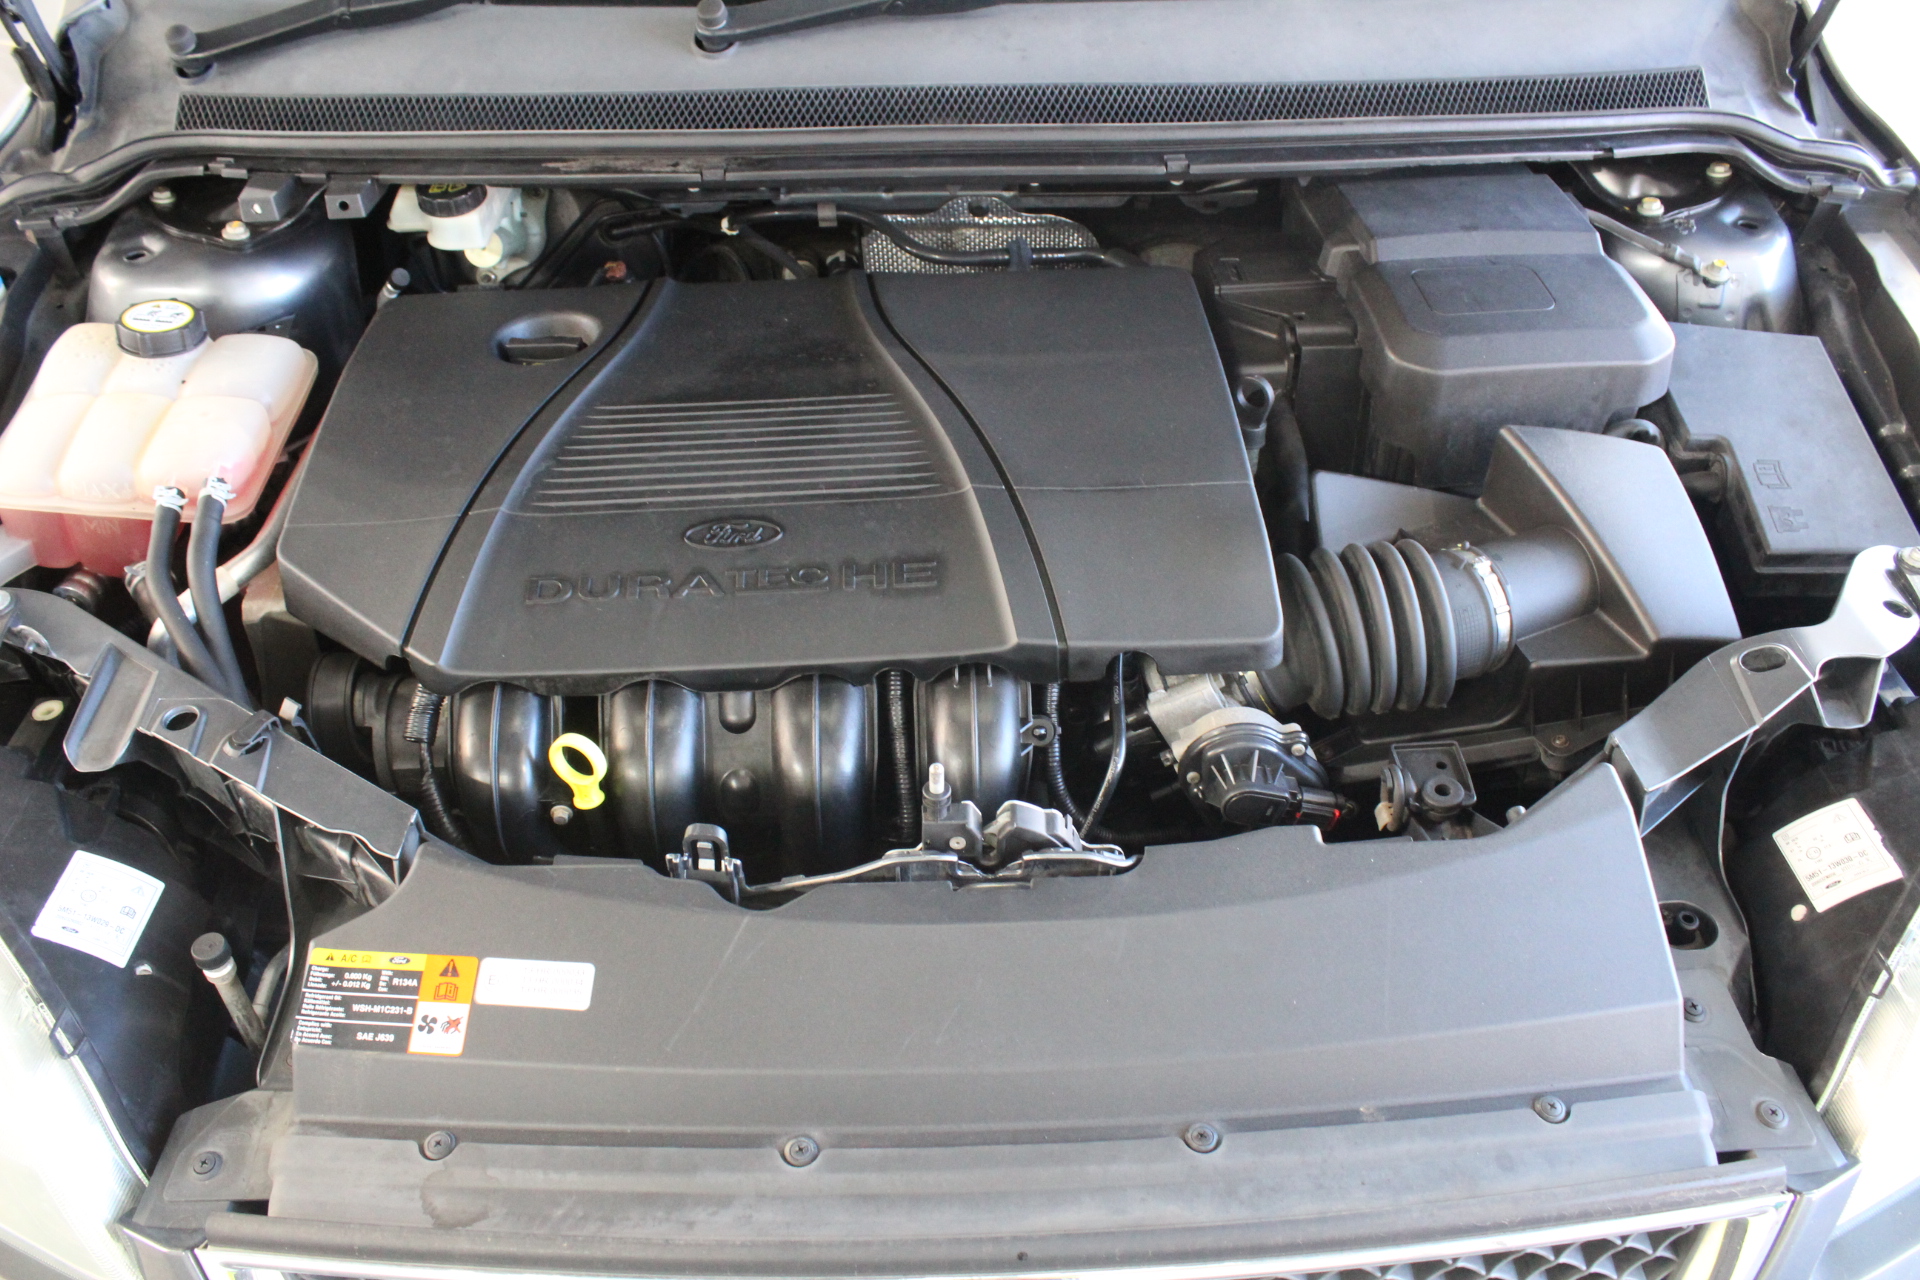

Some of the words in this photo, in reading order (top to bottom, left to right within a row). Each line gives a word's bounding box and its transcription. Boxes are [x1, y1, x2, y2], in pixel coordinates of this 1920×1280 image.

[524, 566, 830, 606] DURATEC
[842, 560, 939, 593] HE
[341, 954, 358, 963] A/C
[362, 973, 373, 982] Kg
[392, 977, 418, 987] R134A
[343, 980, 361, 989] 0.012
[361, 981, 372, 990] Kg
[352, 1003, 414, 1015] WSH-M1C231-B
[356, 1032, 374, 1041] SAE
[374, 1033, 395, 1042] J639
